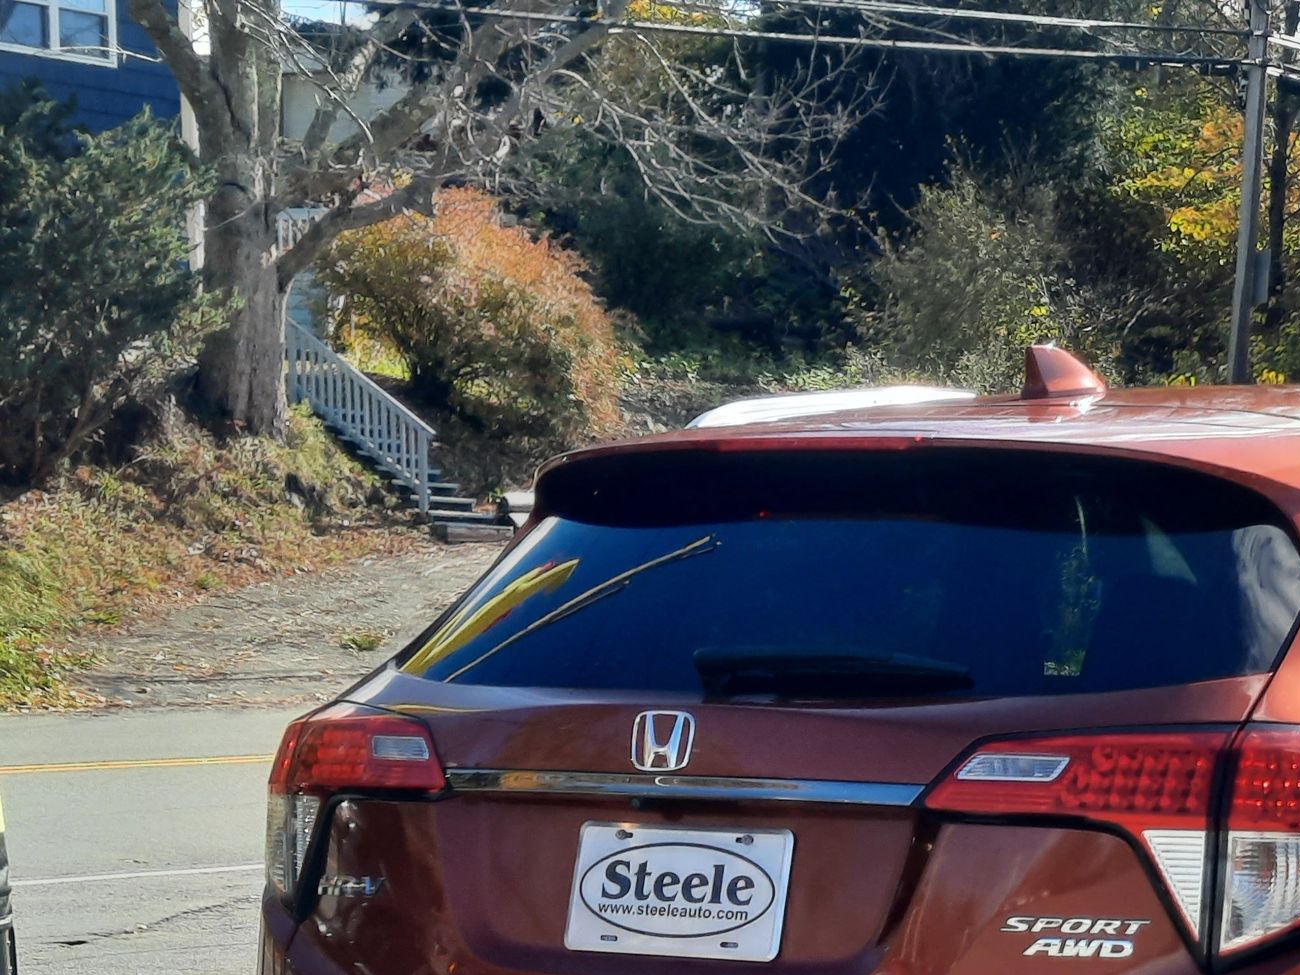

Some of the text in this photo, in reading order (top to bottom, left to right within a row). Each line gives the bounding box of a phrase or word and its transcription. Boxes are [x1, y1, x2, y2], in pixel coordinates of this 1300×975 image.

[601, 860, 755, 906] Steele
[598, 903, 749, 921] www.steeleauto.com
[1000, 917, 1151, 935] SPORT
[1022, 938, 1134, 958] AWD
